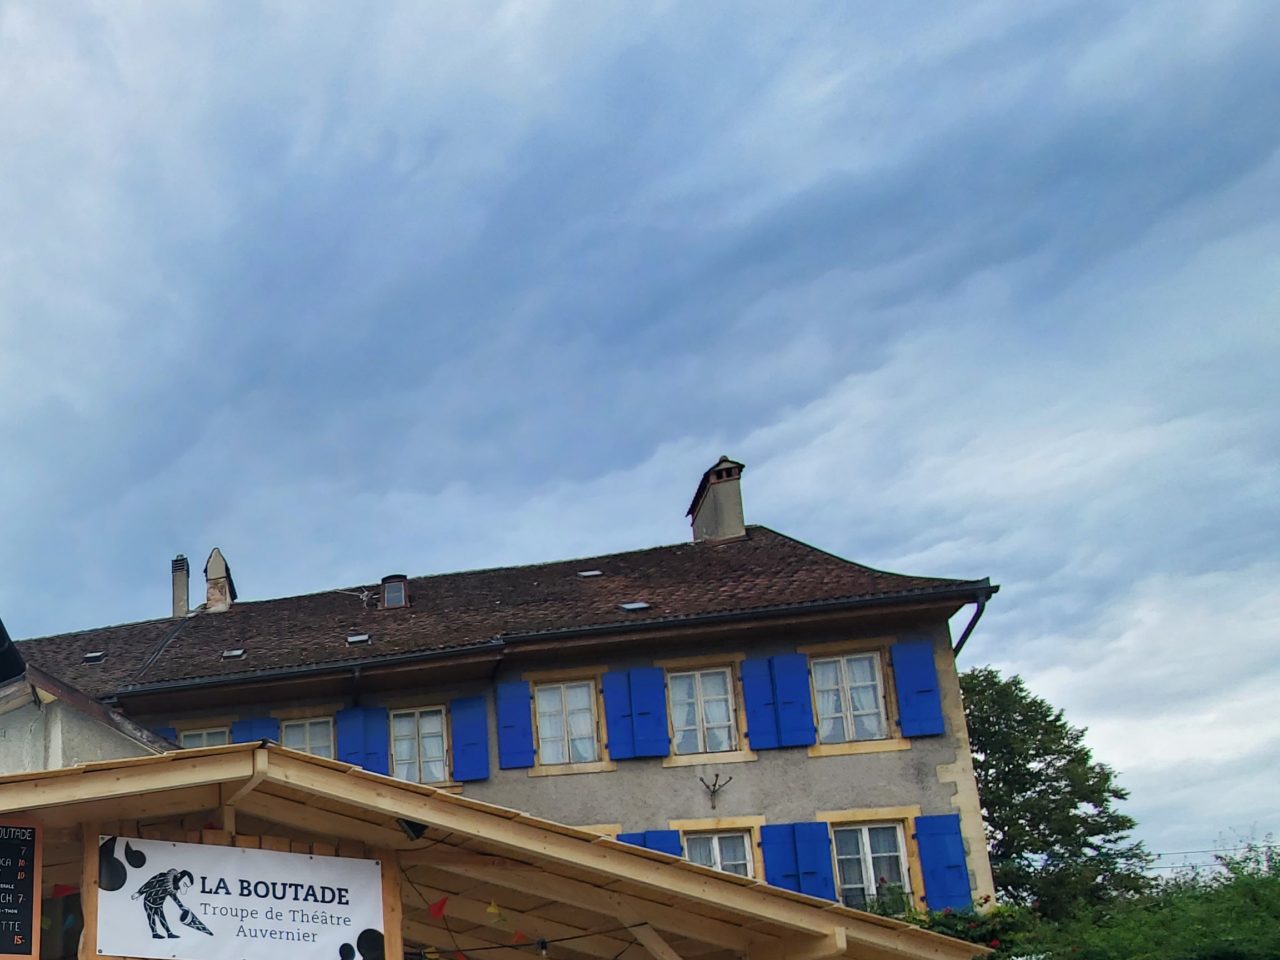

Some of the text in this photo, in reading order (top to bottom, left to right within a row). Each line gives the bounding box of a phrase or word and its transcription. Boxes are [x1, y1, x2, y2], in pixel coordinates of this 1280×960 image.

[200, 876, 350, 906] LA BOUTADE
[200, 902, 352, 926] Troupe de Théâtre
[235, 925, 319, 942] Auvernier
